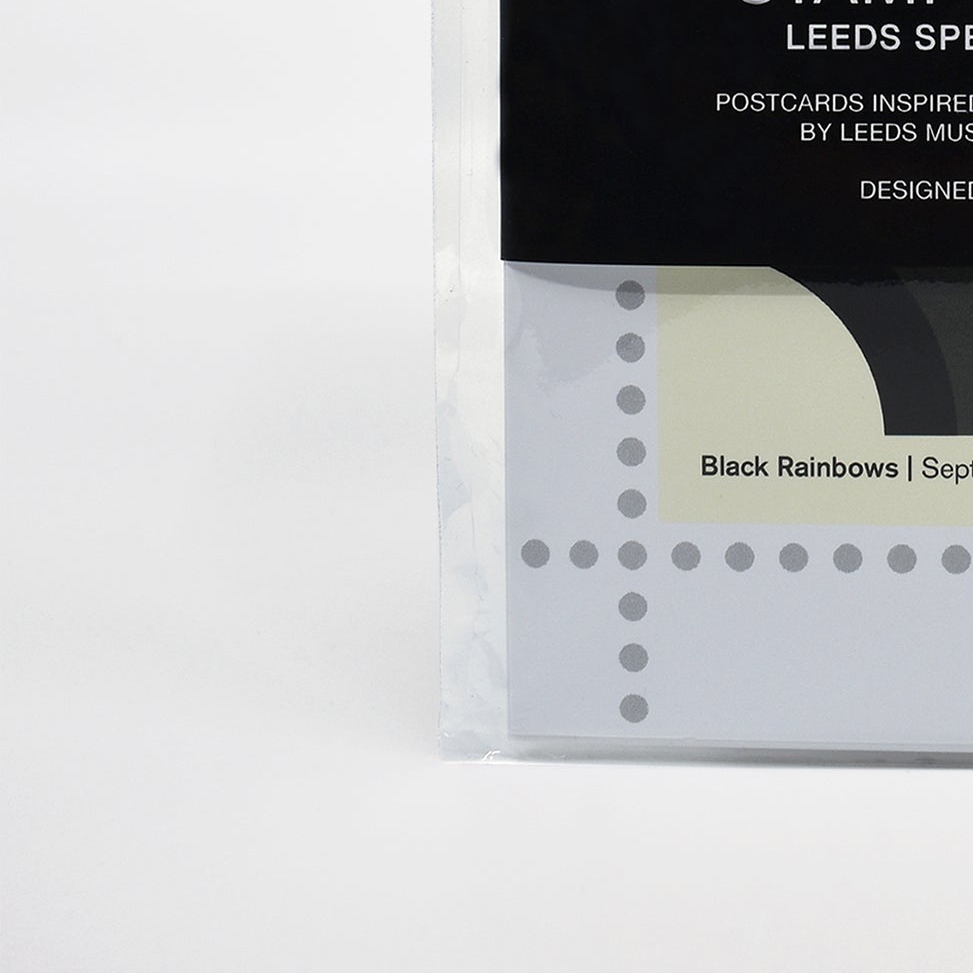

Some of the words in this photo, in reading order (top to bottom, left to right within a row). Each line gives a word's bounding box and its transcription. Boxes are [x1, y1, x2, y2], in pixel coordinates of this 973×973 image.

[786, 23, 901, 51] LEEDS
[716, 92, 864, 113] POSTCARDS
[800, 122, 832, 141] BY
[840, 122, 918, 142] LEEDS
[701, 454, 769, 477] Black
[778, 455, 899, 479] Rainbows
